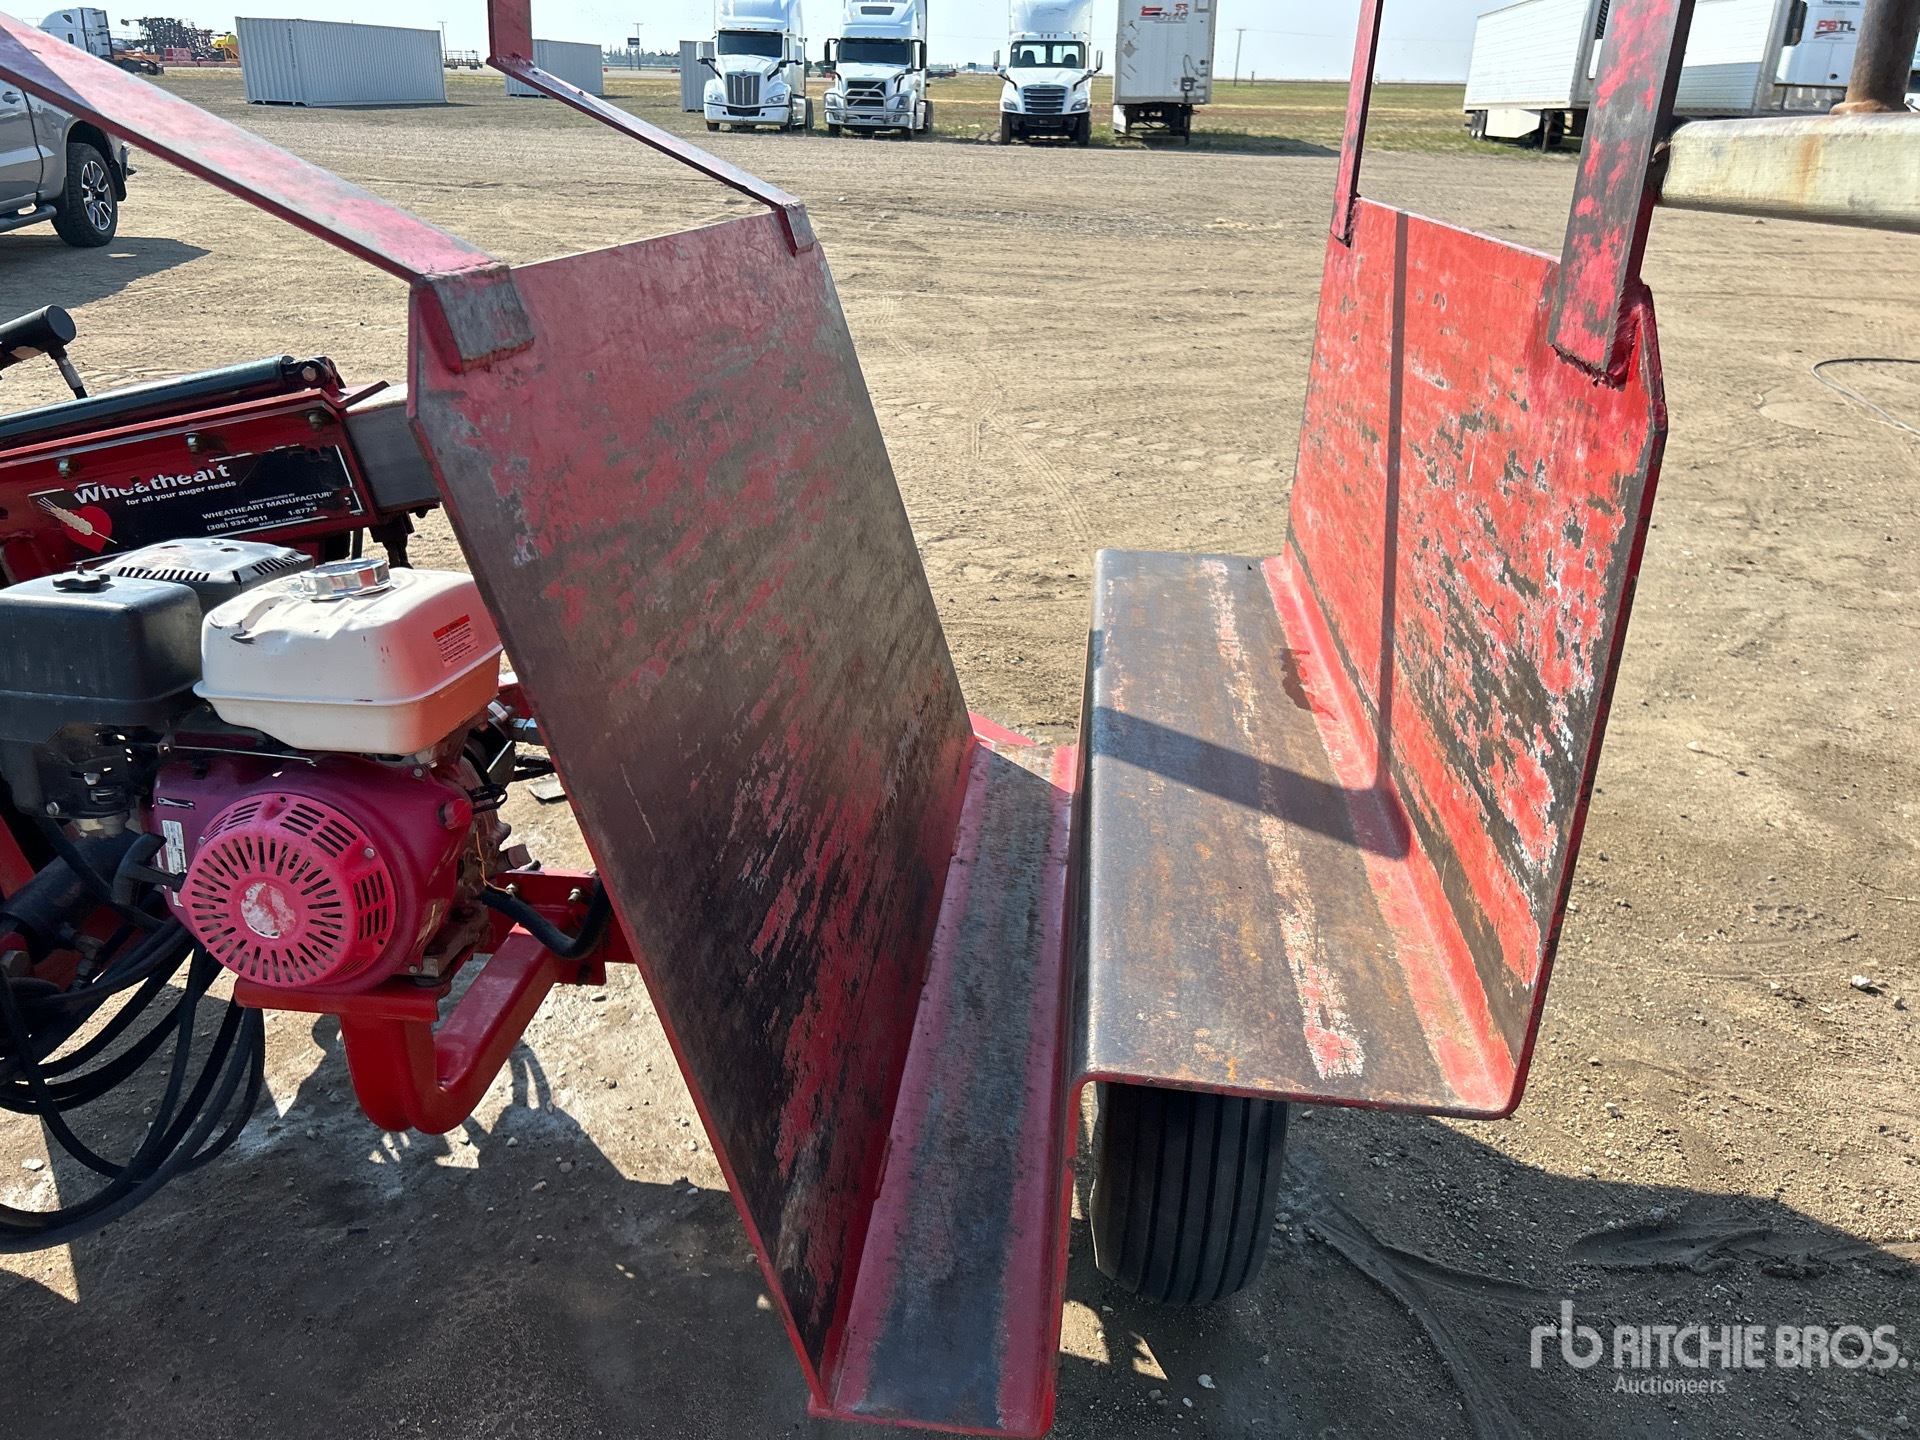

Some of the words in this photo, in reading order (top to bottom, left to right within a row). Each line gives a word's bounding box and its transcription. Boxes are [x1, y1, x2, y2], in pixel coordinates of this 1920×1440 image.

[126, 498, 139, 506] for
[155, 491, 176, 502] your
[179, 486, 205, 497] auger
[207, 480, 237, 490] needs
[202, 503, 264, 519] WHEATHEART
